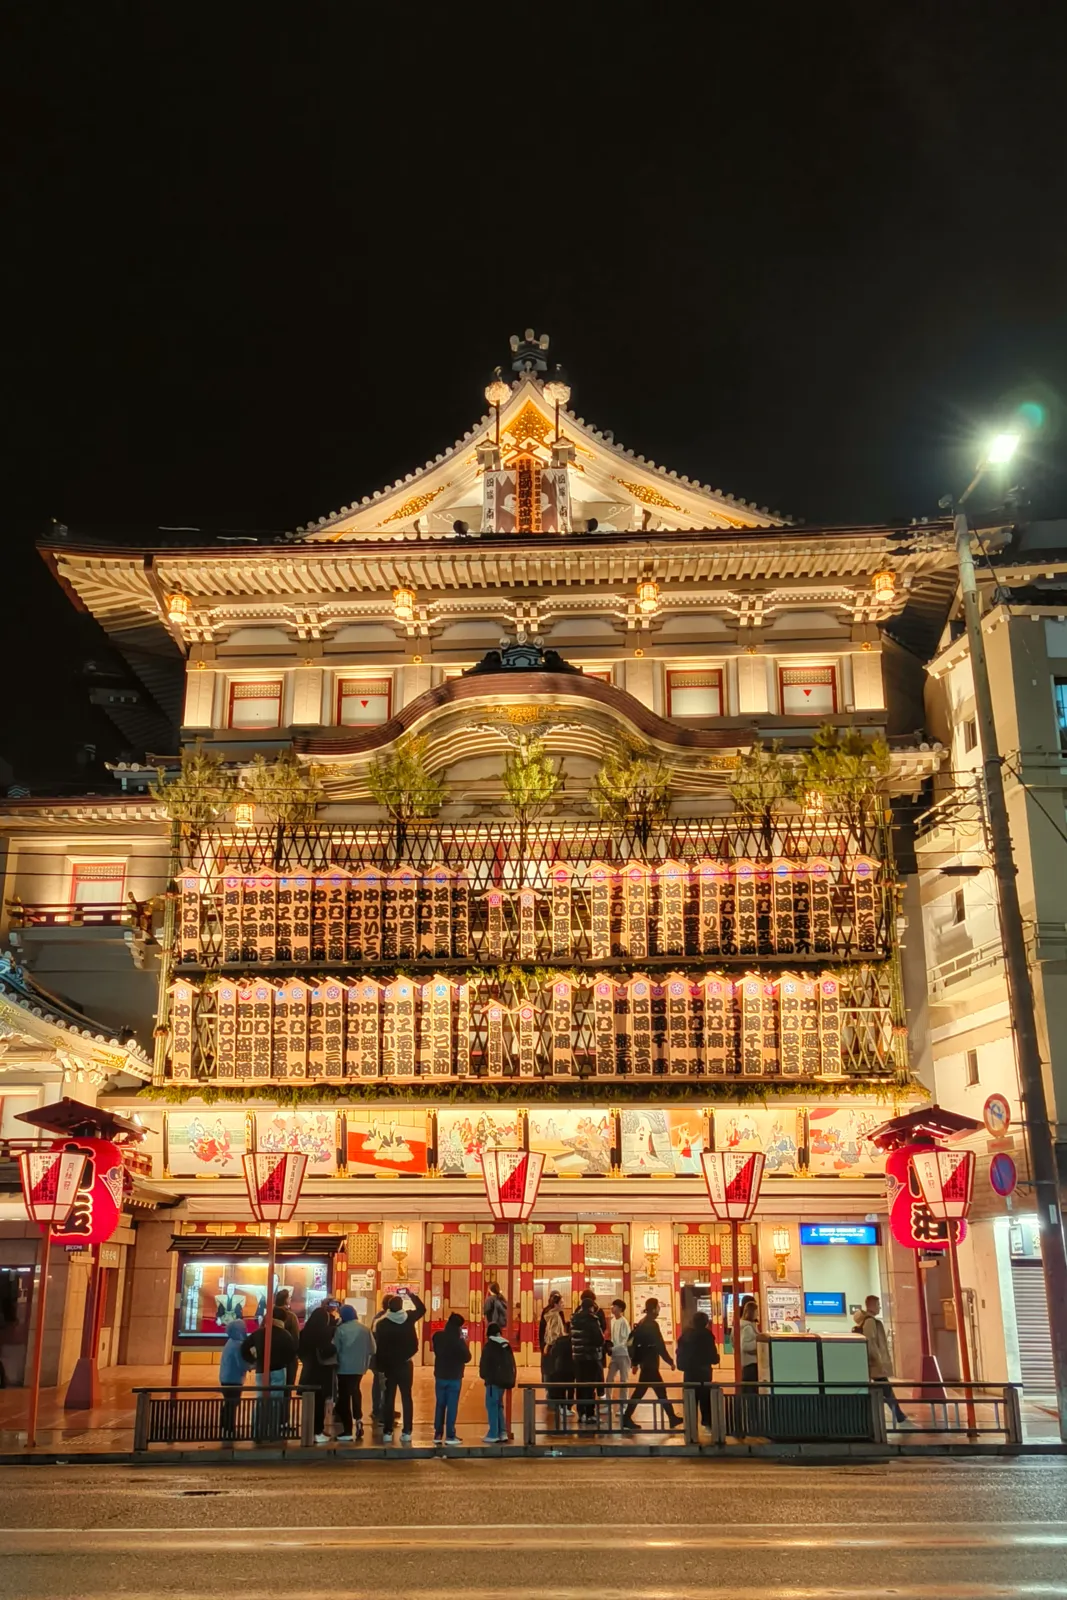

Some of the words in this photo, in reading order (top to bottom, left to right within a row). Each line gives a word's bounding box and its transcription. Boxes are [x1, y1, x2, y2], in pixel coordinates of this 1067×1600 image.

[720, 883, 737, 955] 中村かなめ
